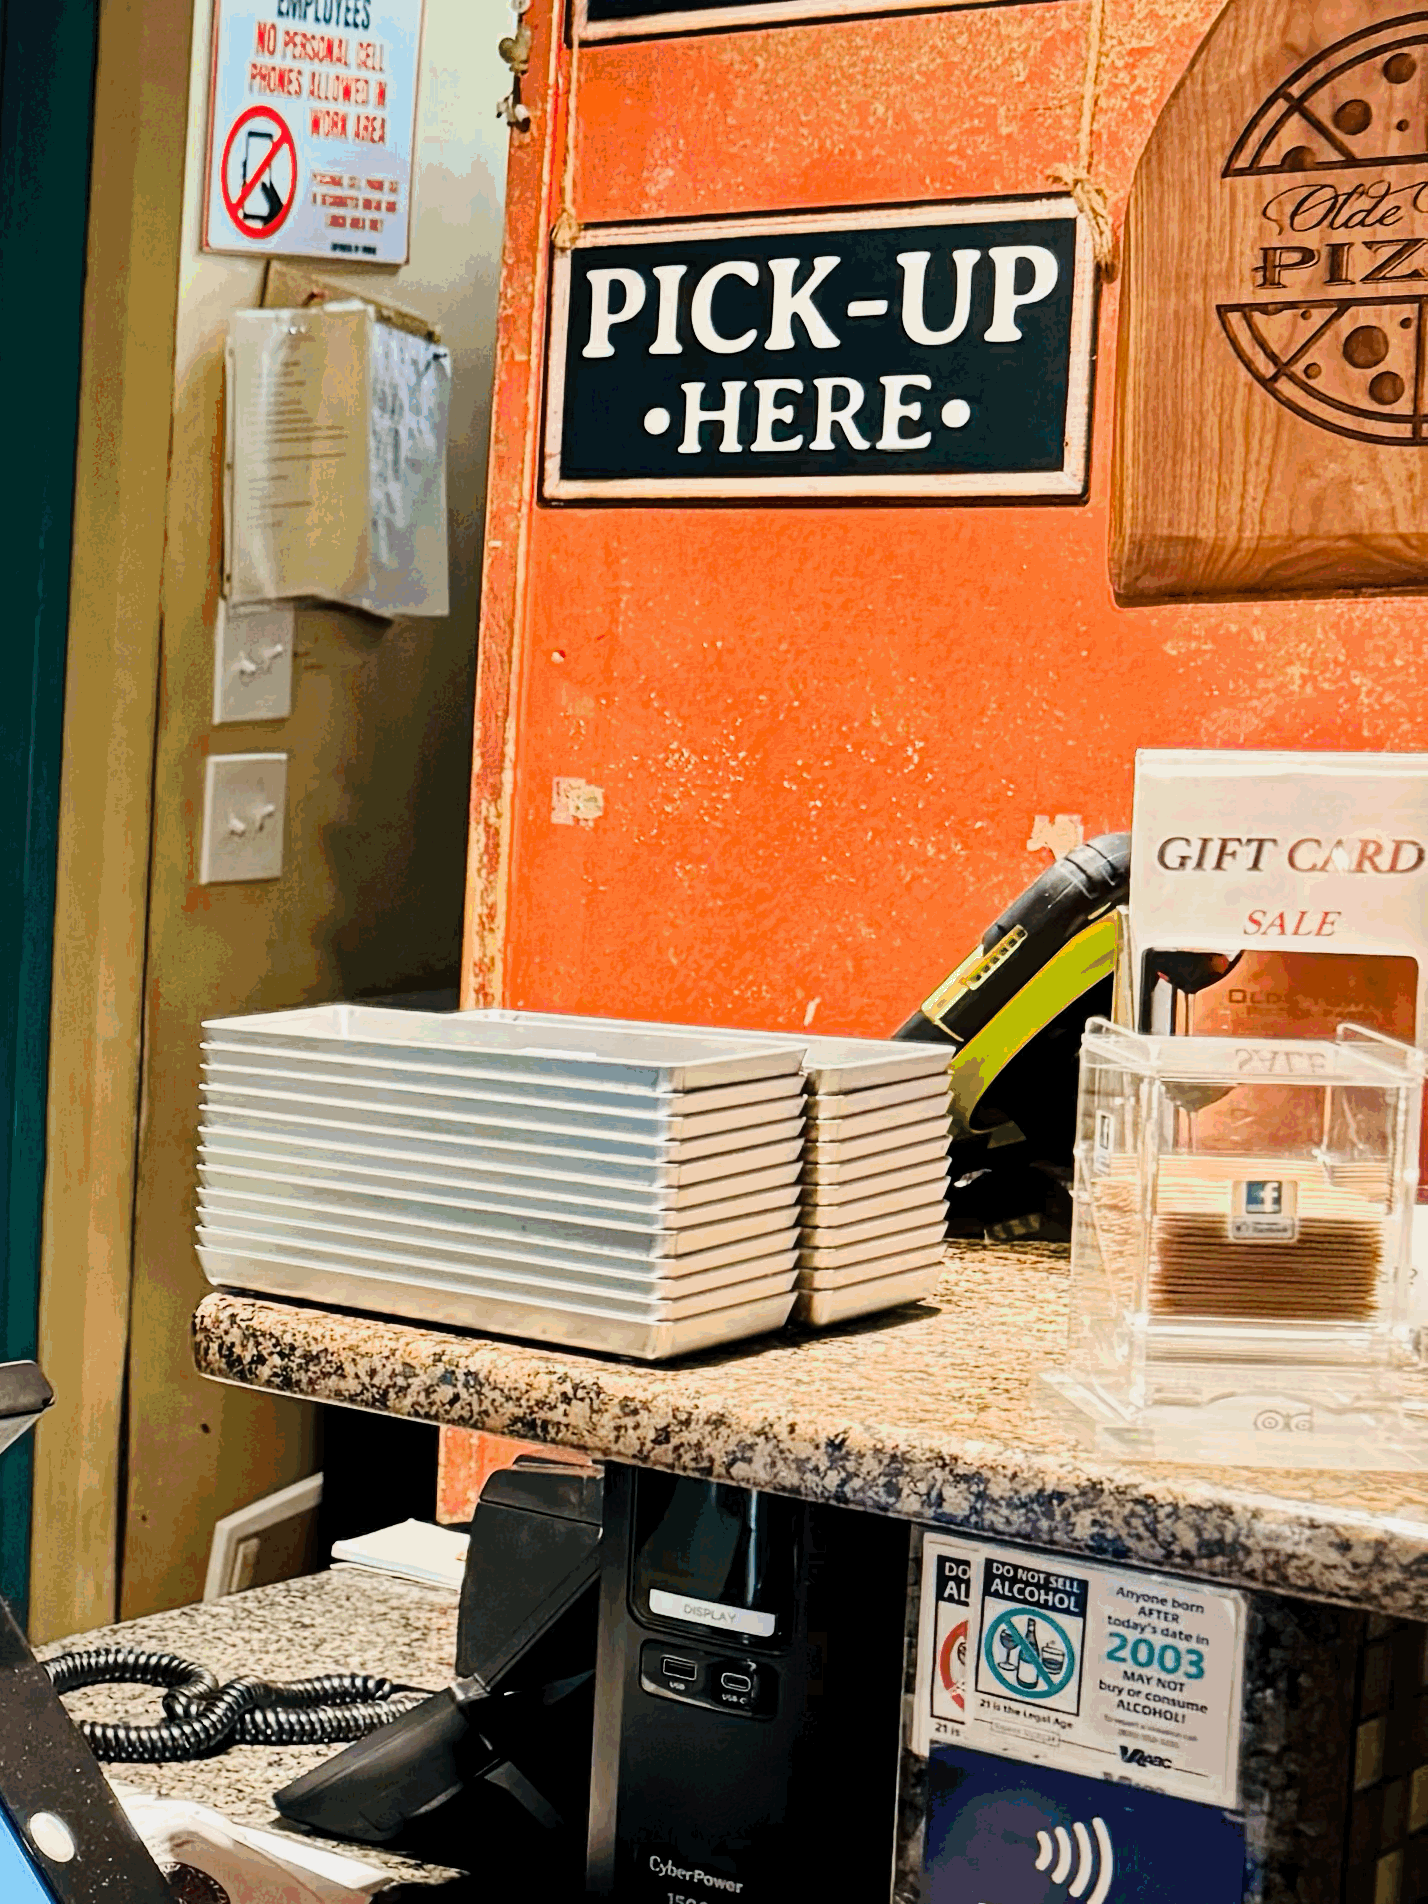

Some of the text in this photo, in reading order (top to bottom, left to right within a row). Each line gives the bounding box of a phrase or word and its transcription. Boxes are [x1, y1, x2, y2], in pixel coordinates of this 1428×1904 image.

[255, 20, 384, 73] NO PERSONAL CELL
[249, 62, 387, 108] PHONES ALLOWED IN
[310, 107, 386, 144] WORK AREA
[1262, 180, 1403, 237] Olde
[583, 245, 1059, 359] PICK-UP
[1156, 835, 1425, 876] GIFT CARD
[1243, 908, 1342, 939] SALE
[944, 1561, 970, 1579] DO
[992, 1562, 1081, 1593] DO NOT SELL
[990, 1578, 1080, 1613] ALCOHOL
[1116, 1587, 1205, 1615] Anyone born
[683, 1603, 737, 1624] DISPLAY
[1138, 1606, 1180, 1624] AFTER
[1107, 1615, 1209, 1646] today's date in
[1106, 1631, 1205, 1681] 2003
[1099, 1679, 1209, 1714] buy or consume
[1122, 1670, 1186, 1693] MAY NOT
[979, 1699, 1075, 1730] 21 is the Legal Age
[1116, 1699, 1186, 1724] ALCOHOL!
[935, 1721, 961, 1737] 21 is
[649, 1855, 744, 1894] CyberPower
